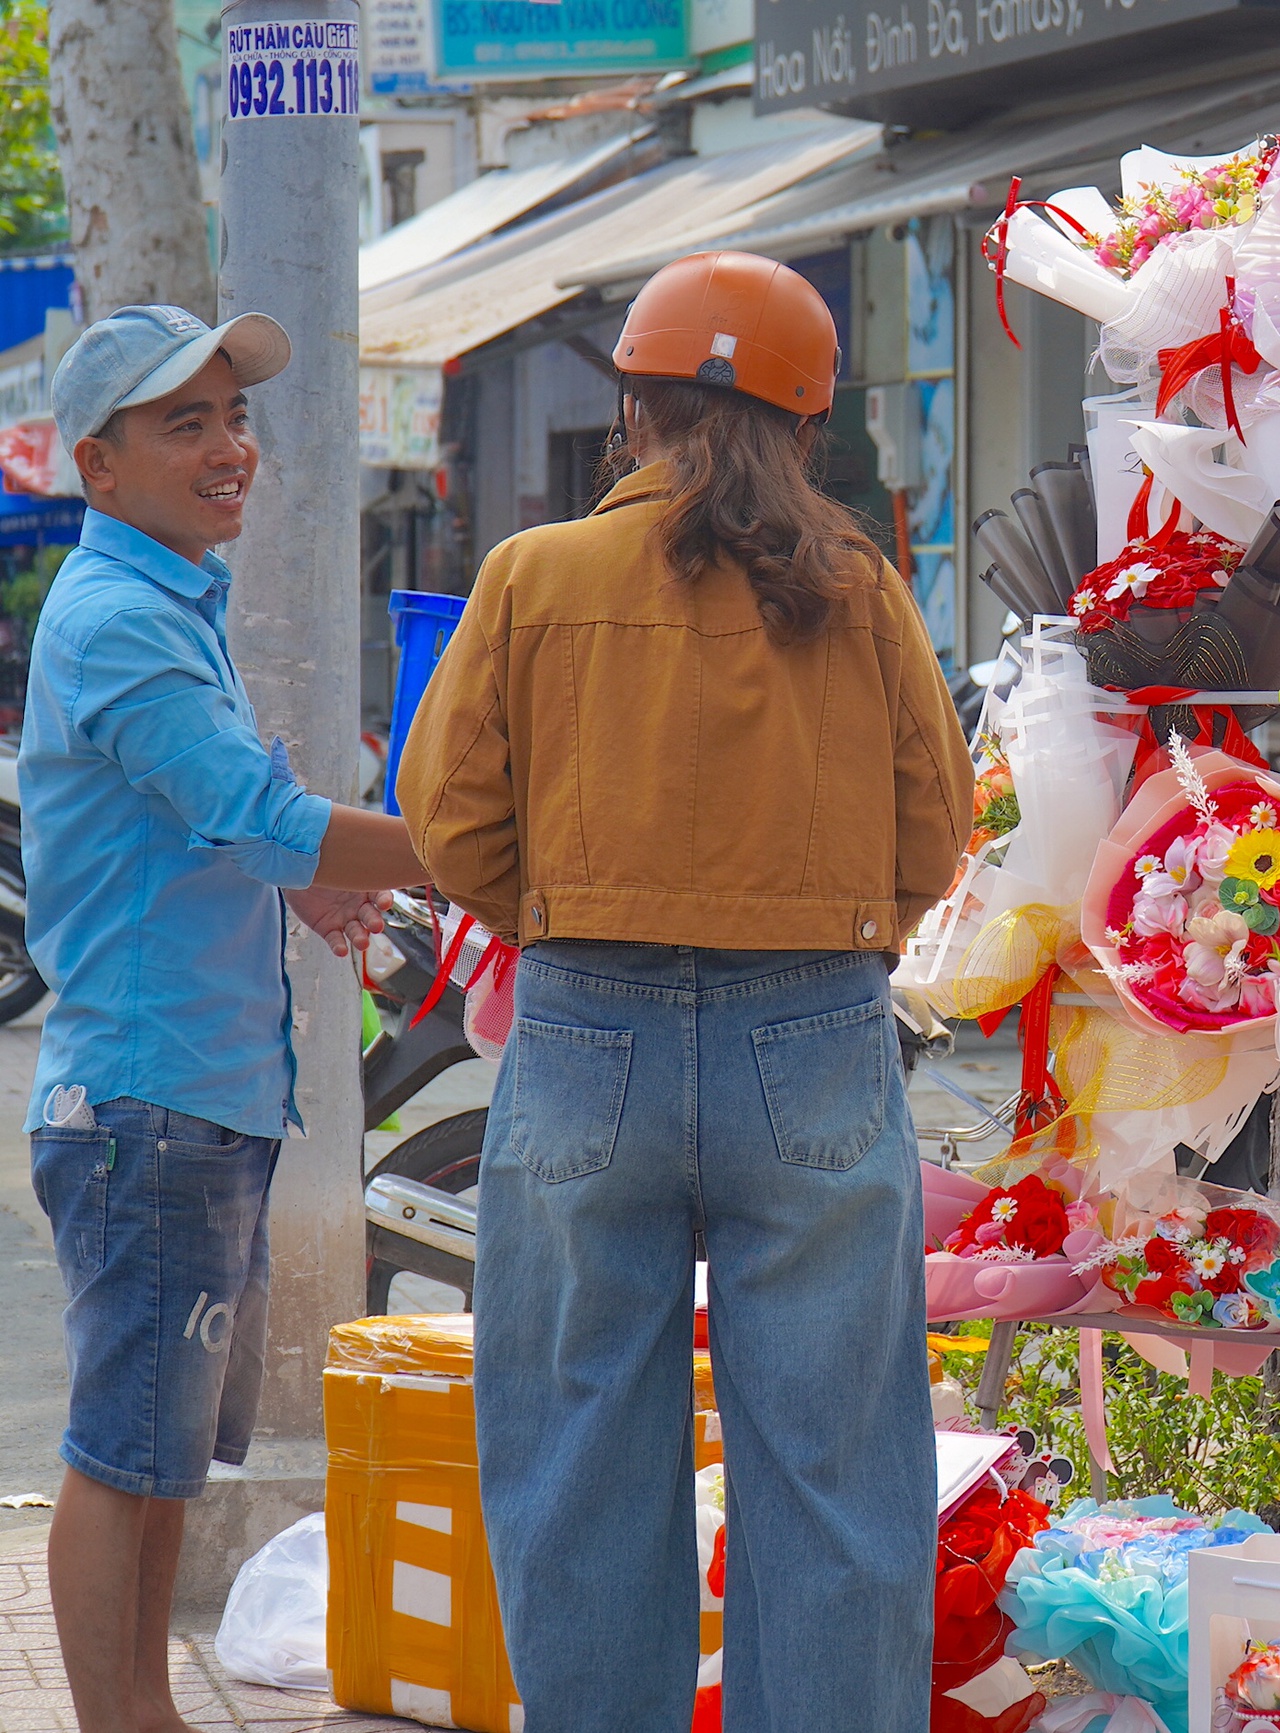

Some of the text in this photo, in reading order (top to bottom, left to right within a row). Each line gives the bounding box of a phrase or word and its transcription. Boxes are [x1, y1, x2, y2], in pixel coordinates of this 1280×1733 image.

[230, 26, 252, 54] RÚT
[255, 23, 290, 50] HẦM
[292, 22, 324, 49] CẦU
[270, 49, 298, 59] THÔNG
[760, 40, 805, 100] Hoa
[866, 5, 918, 73] Đính
